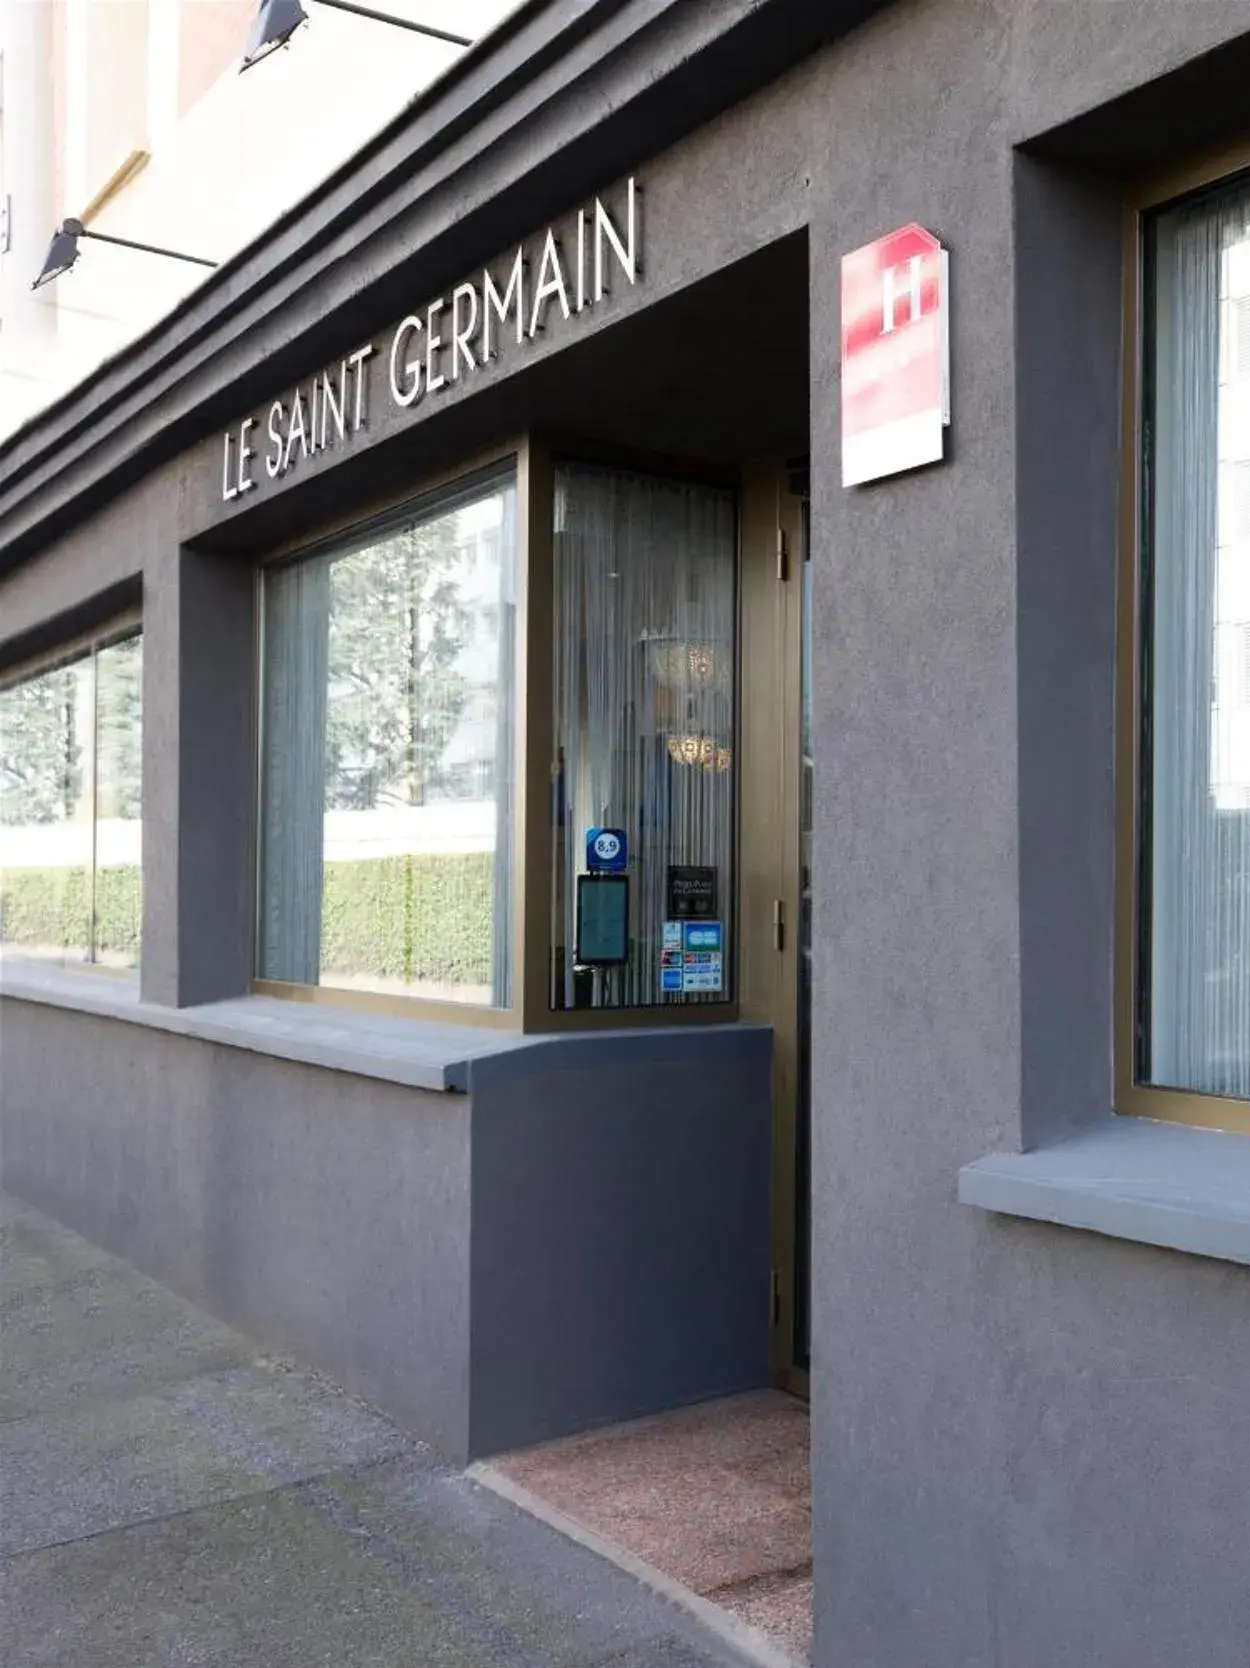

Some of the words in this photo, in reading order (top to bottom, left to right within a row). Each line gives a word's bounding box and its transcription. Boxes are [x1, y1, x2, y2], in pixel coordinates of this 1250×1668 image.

[880, 255, 924, 336] H
[222, 417, 254, 501] LE
[265, 343, 374, 478] SAINT
[389, 176, 636, 407] GERMAIN
[597, 839, 617, 853] 8,9
